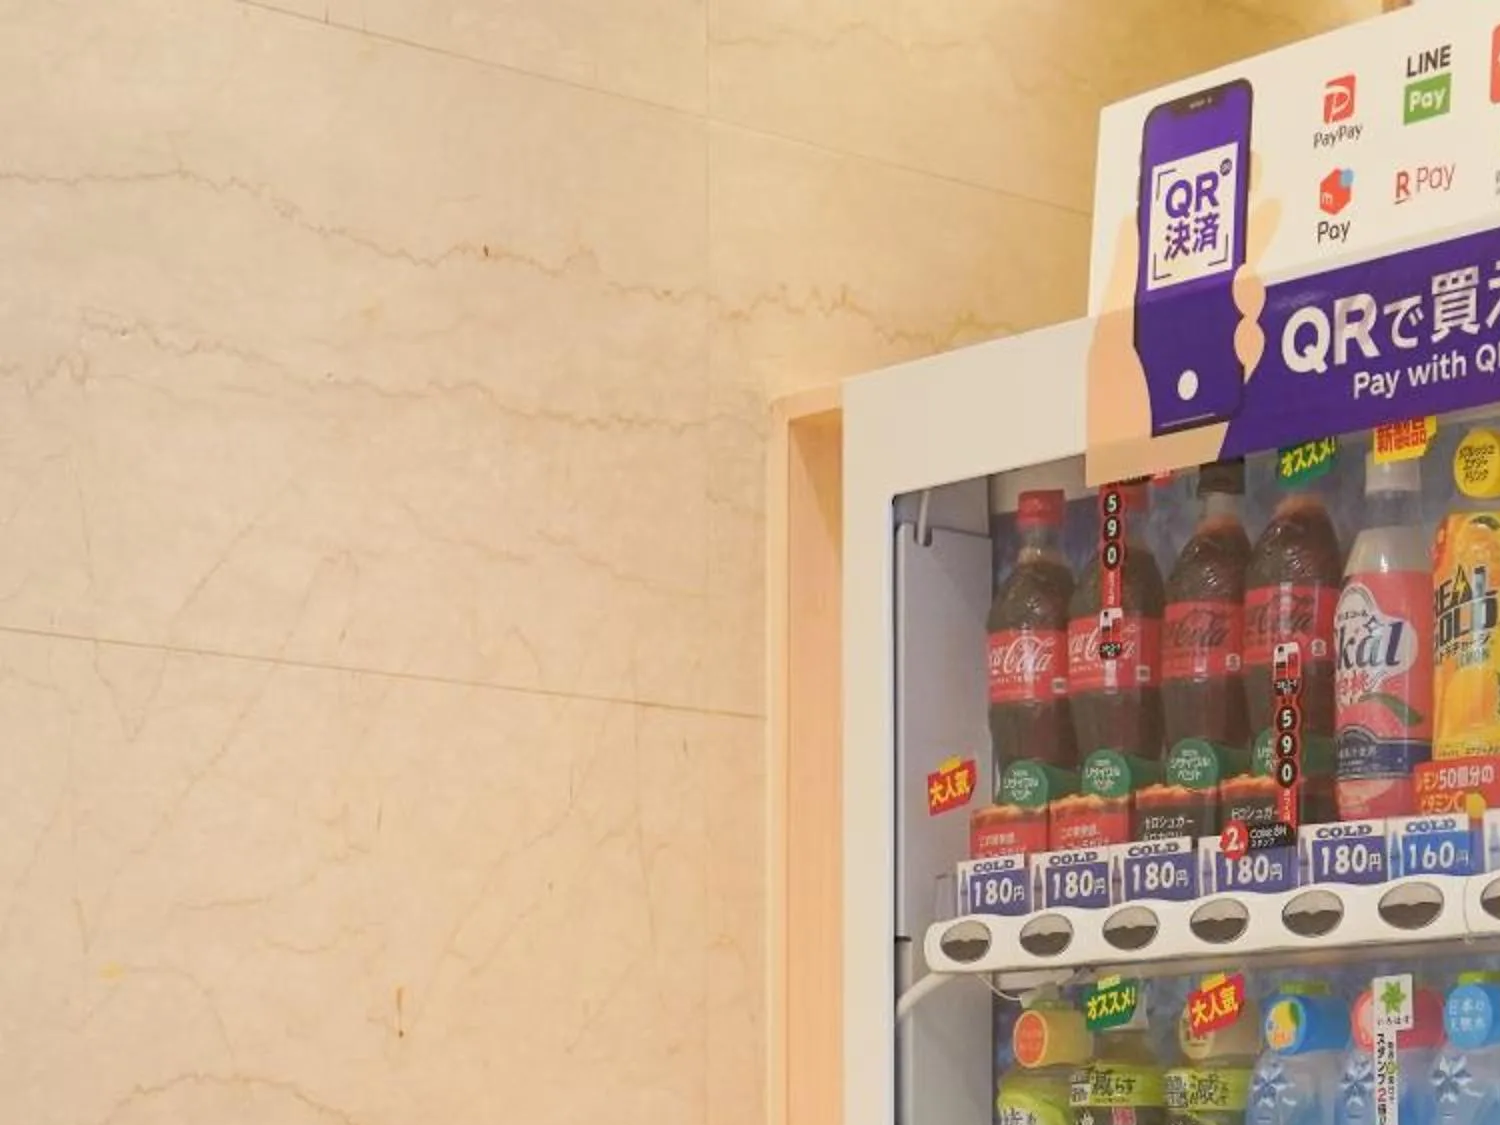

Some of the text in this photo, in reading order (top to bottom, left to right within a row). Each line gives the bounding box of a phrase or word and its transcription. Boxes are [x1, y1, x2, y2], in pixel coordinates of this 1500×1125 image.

[1406, 45, 1452, 78] LINE
[1409, 88, 1447, 113] Pay
[1313, 122, 1364, 150] PayPay
[1166, 171, 1222, 220] QR
[1164, 213, 1222, 262] 決済
[1316, 221, 1351, 244] Pay
[1353, 363, 1400, 399] Pay
[1408, 349, 1468, 388] with
[928, 769, 971, 804] 大人気
[1316, 823, 1373, 840] COLD
[1320, 844, 1383, 875] 180円
[1407, 841, 1470, 870] 160円
[1051, 869, 1107, 901] 180円
[1131, 861, 1190, 891] 180円
[1223, 856, 1284, 887] 180円
[974, 878, 1025, 908] 180円
[1086, 985, 1137, 1021] オススメ!
[1190, 985, 1240, 1028] 大人気
